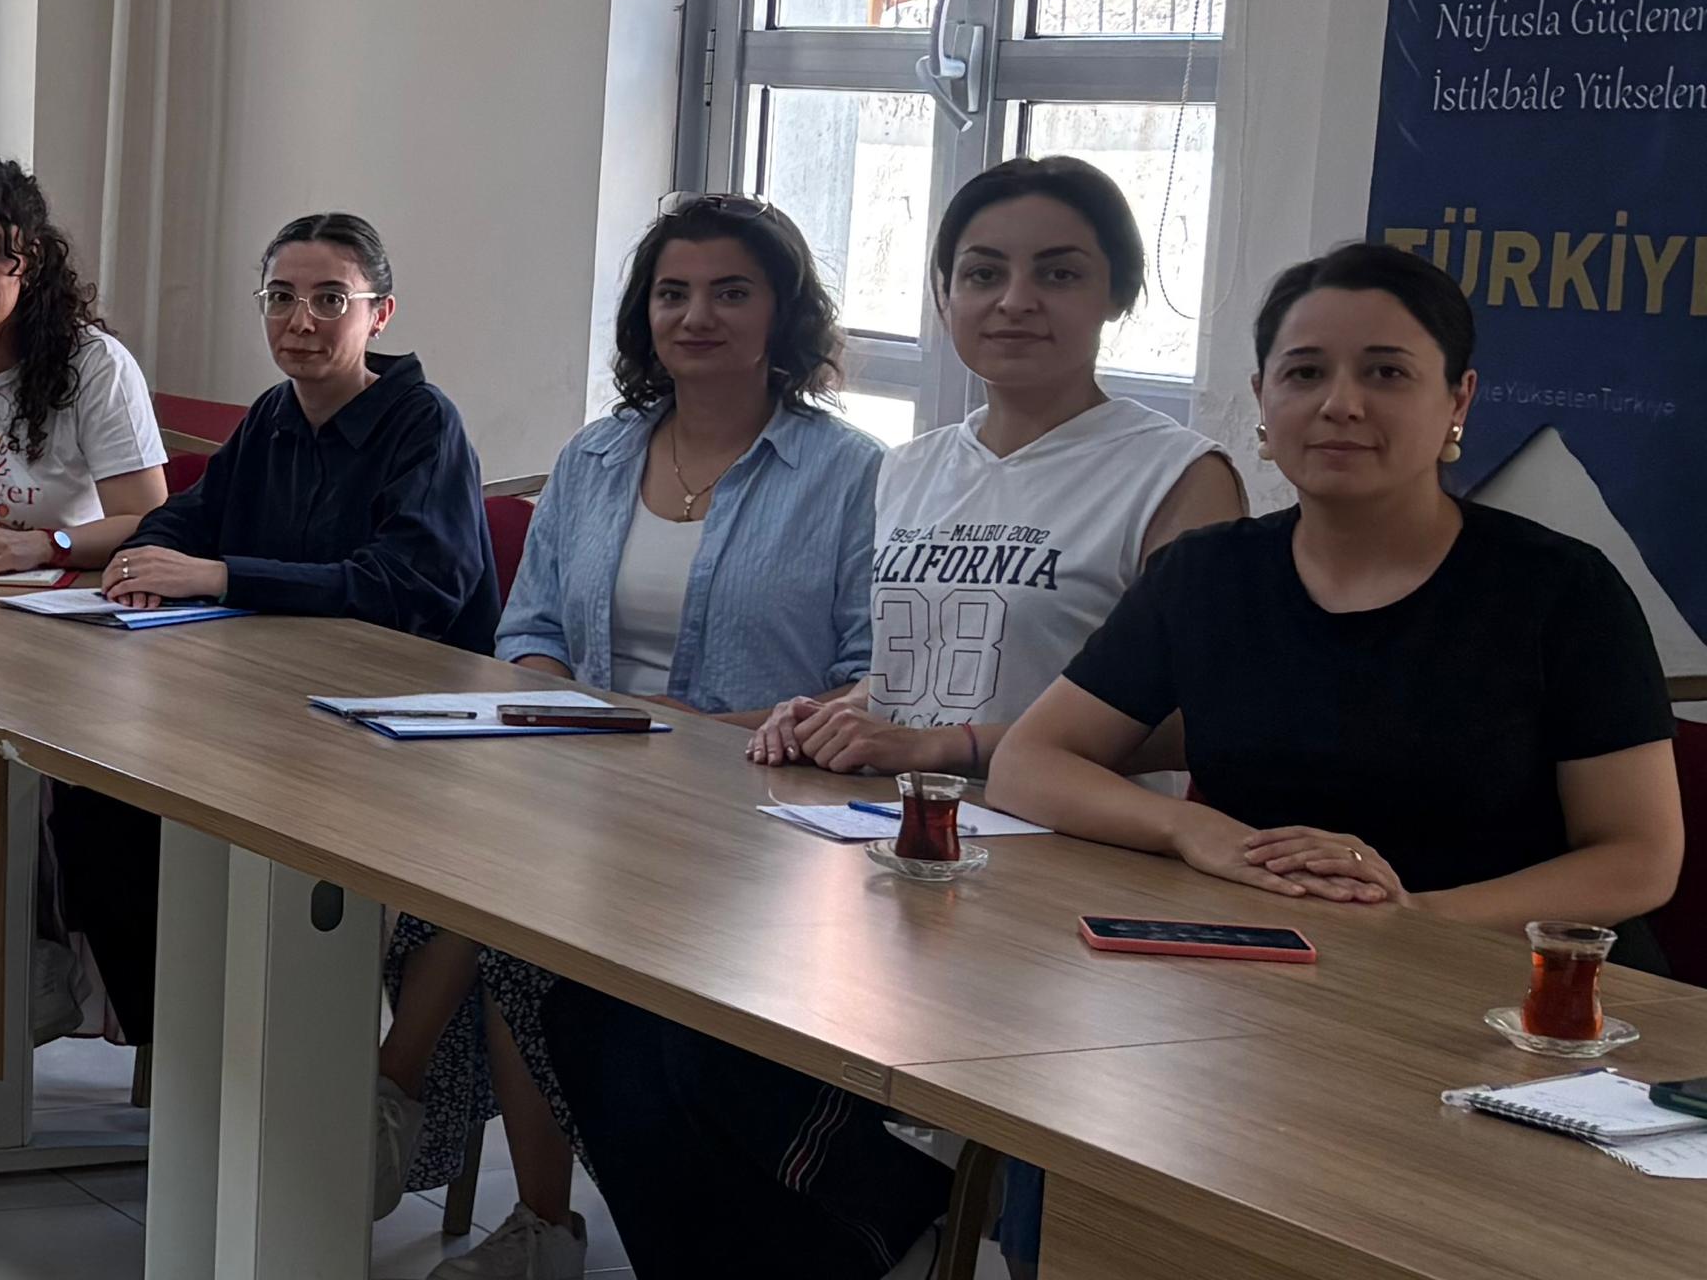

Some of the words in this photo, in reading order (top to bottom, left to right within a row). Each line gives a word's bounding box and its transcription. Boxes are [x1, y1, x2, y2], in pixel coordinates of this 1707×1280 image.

[1433, 67, 1565, 111] İstikbâle
[1574, 65, 1707, 110] Yükselen
[873, 543, 1063, 591] ALIFORNIA
